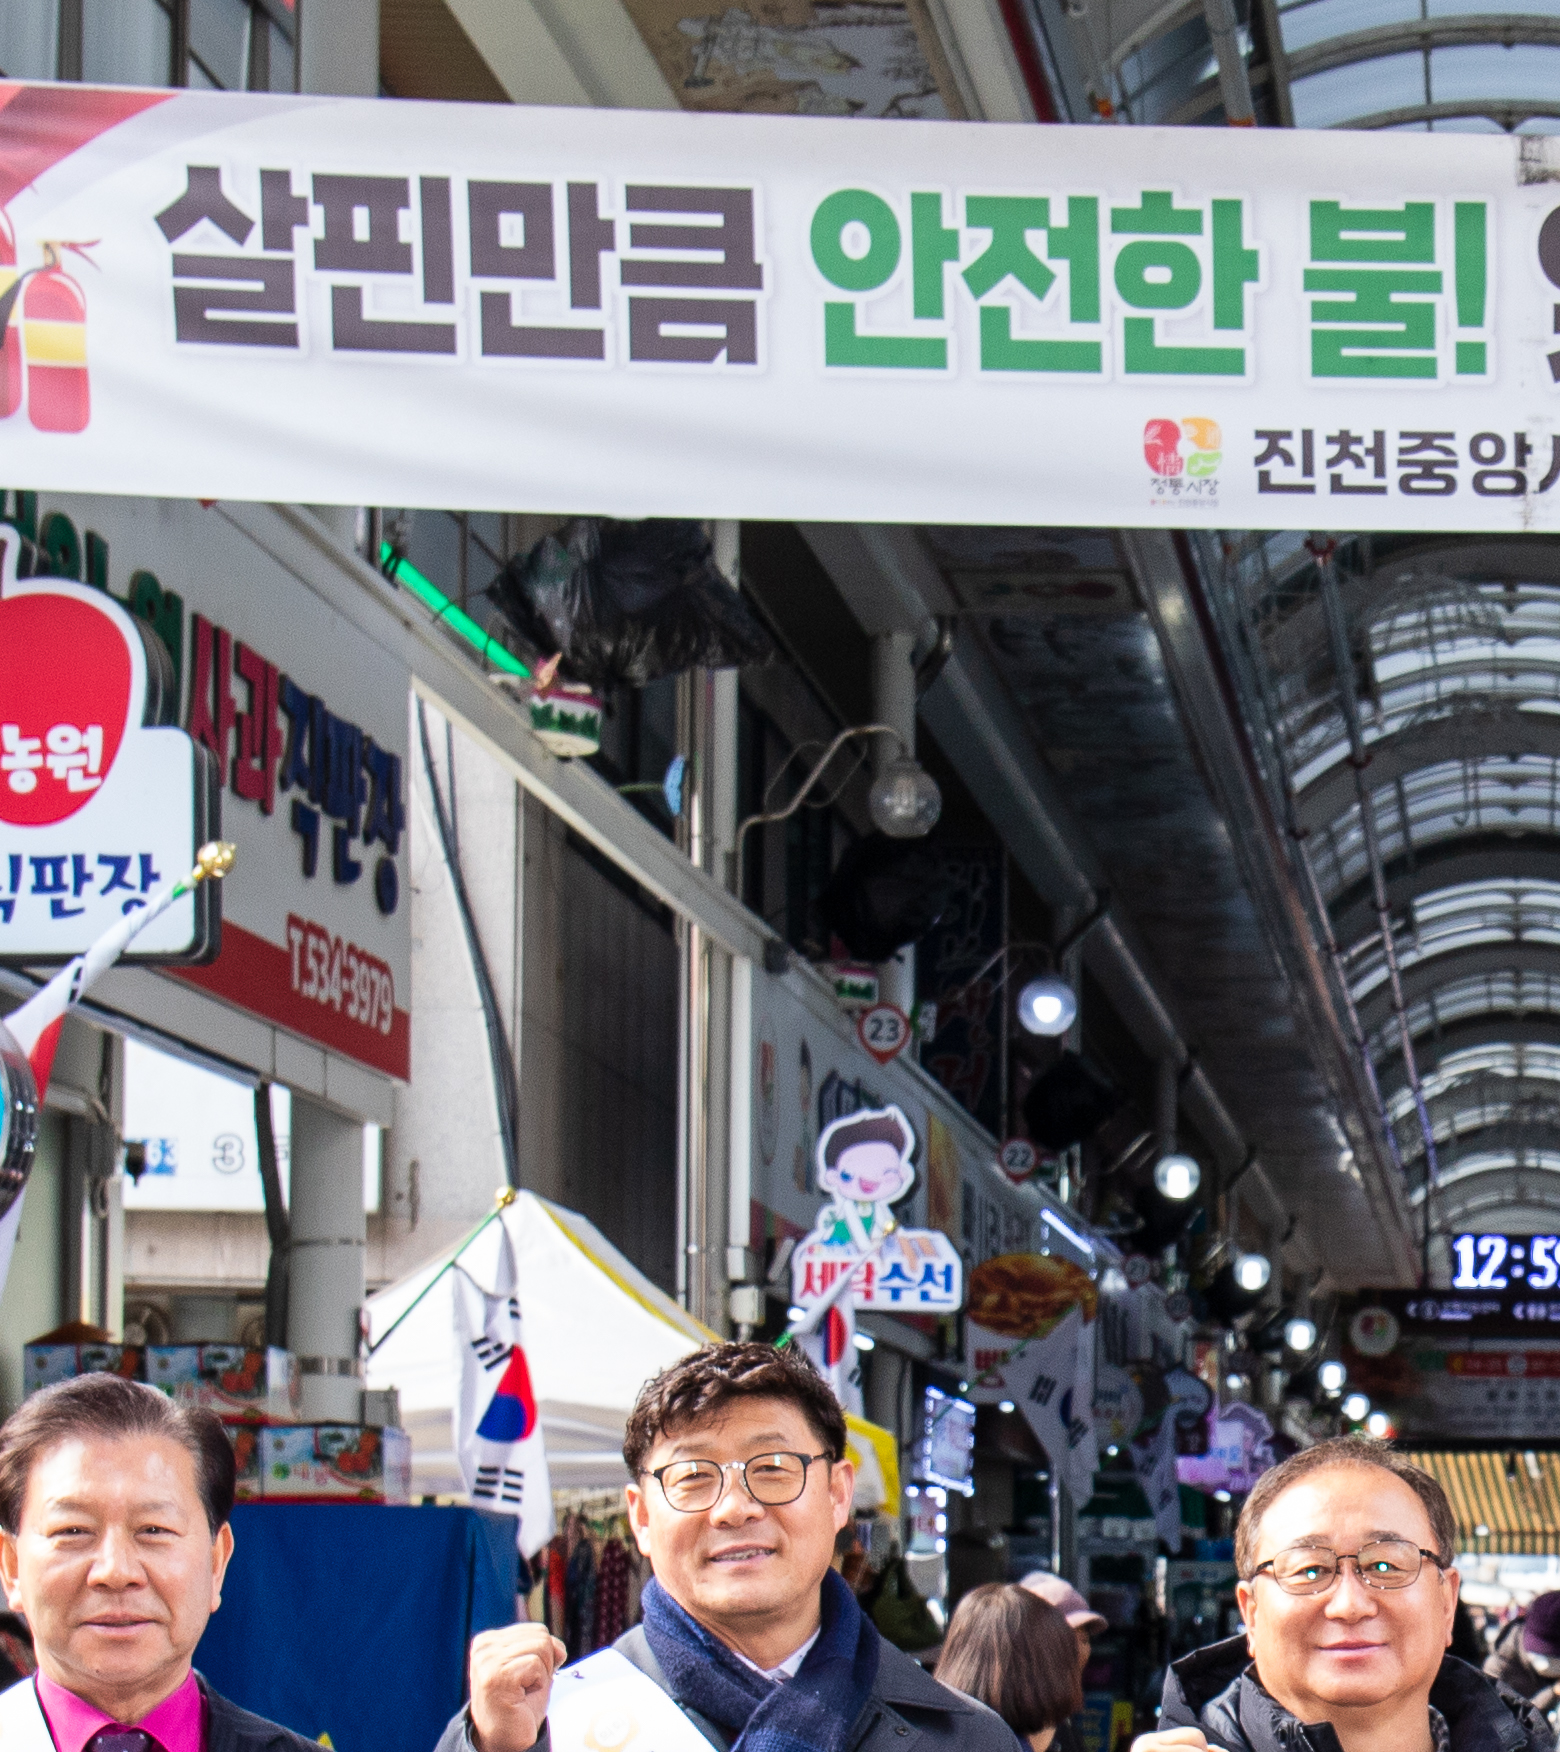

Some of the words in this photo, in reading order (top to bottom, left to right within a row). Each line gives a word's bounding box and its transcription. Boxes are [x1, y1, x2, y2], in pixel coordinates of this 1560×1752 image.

[154, 163, 765, 366] 살핀만큼
[809, 186, 1258, 379] 안전한
[1303, 196, 1489, 381] 불!
[191, 612, 405, 915] 사과직판장
[286, 913, 396, 1036] T.534-3979
[869, 1018, 900, 1043] 23
[799, 1260, 955, 1302] 세탁수선
